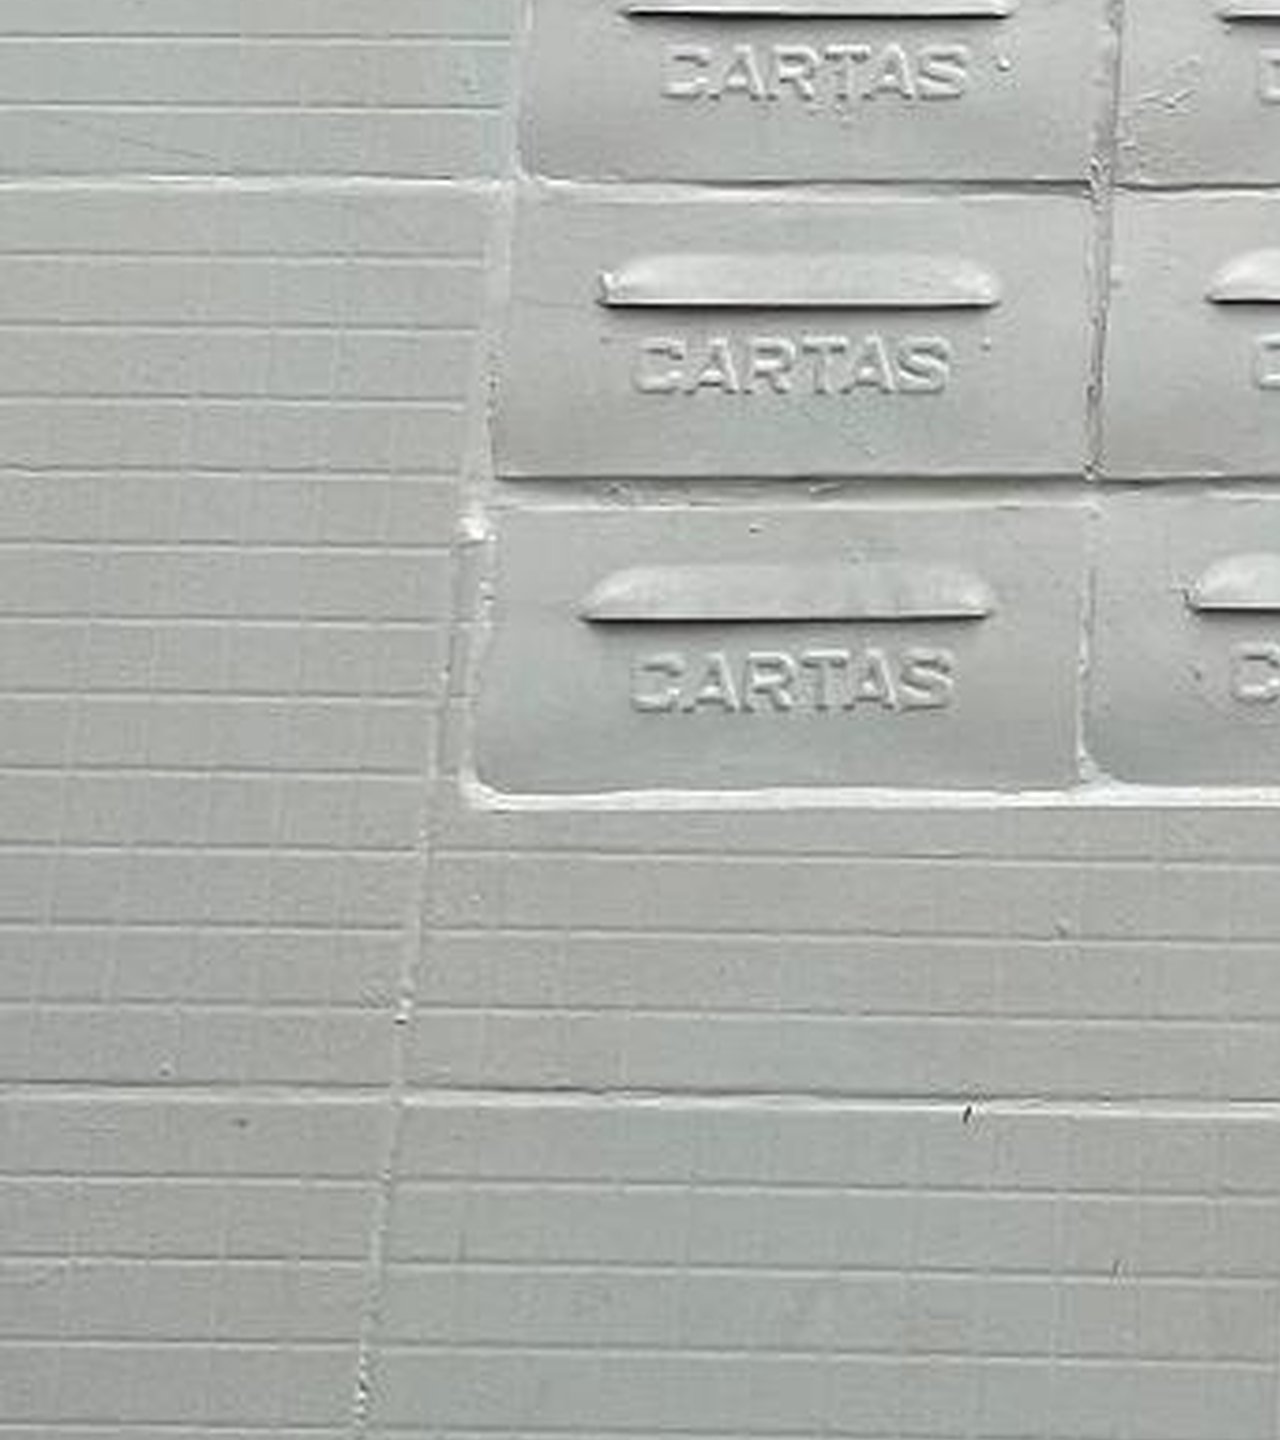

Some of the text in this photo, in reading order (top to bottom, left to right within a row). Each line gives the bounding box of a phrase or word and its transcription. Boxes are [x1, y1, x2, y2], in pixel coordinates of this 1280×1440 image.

[656, 43, 970, 103] CARTAS
[632, 333, 952, 395] CARTAS
[628, 645, 957, 714] CARTAS
